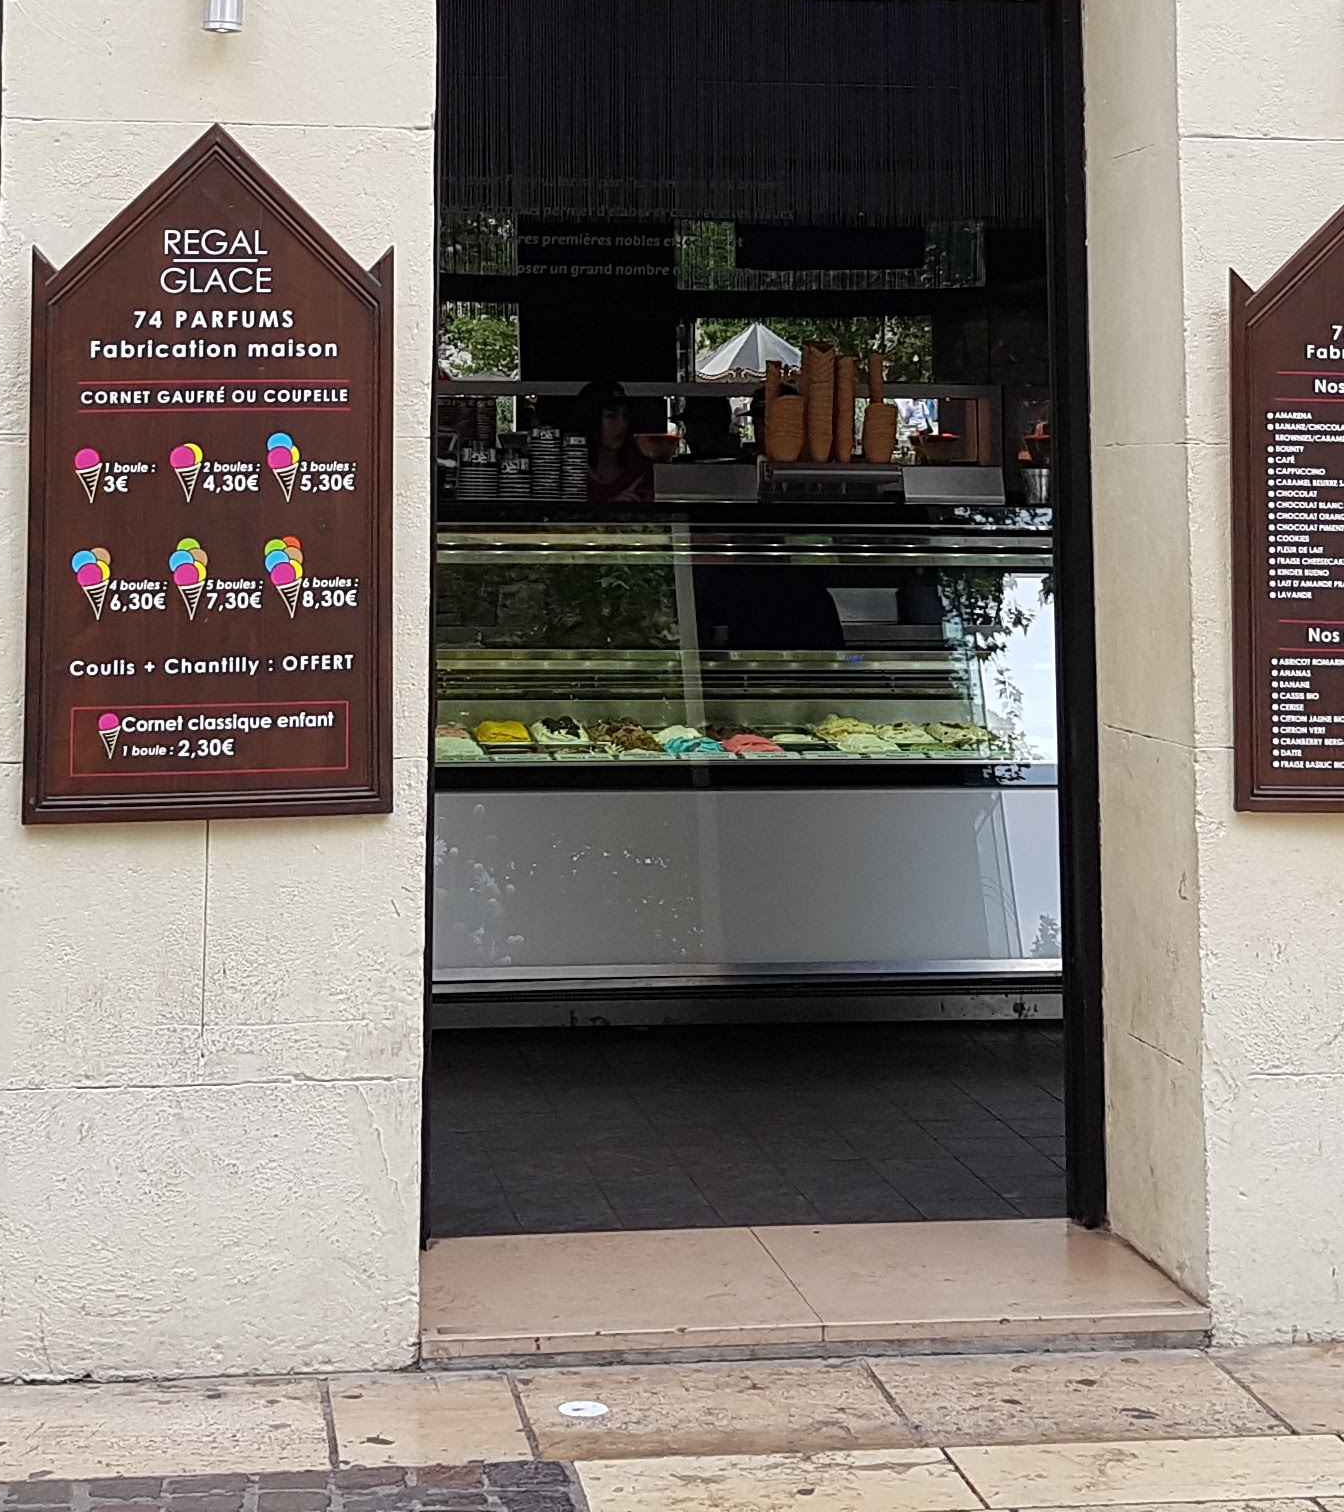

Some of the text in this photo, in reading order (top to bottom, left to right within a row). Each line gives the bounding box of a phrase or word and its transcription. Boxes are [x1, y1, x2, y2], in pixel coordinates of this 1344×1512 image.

[164, 229, 268, 256] REGAL
[542, 231, 661, 248] premières nobles
[549, 261, 670, 279] un grand nombre
[160, 267, 272, 294] GLACE
[133, 310, 294, 329] 74 PARFUMS
[90, 338, 338, 359] Fabrication maison
[80, 386, 348, 405] CORNET GAUFRÉ OU COUPELLE
[103, 475, 128, 493] 3€
[202, 474, 259, 494] 4,30€
[299, 473, 355, 493] 5,30€
[110, 592, 166, 612] 6,30€
[206, 591, 262, 612] 7,30€
[302, 589, 358, 610] 8,30€
[1308, 627, 1340, 643] Nos
[69, 659, 135, 676] Coulis
[164, 656, 260, 676] Chantilly
[282, 654, 354, 672] OFFERT
[121, 711, 334, 733] Cornet classique enfant
[177, 738, 234, 759] 2,30€
